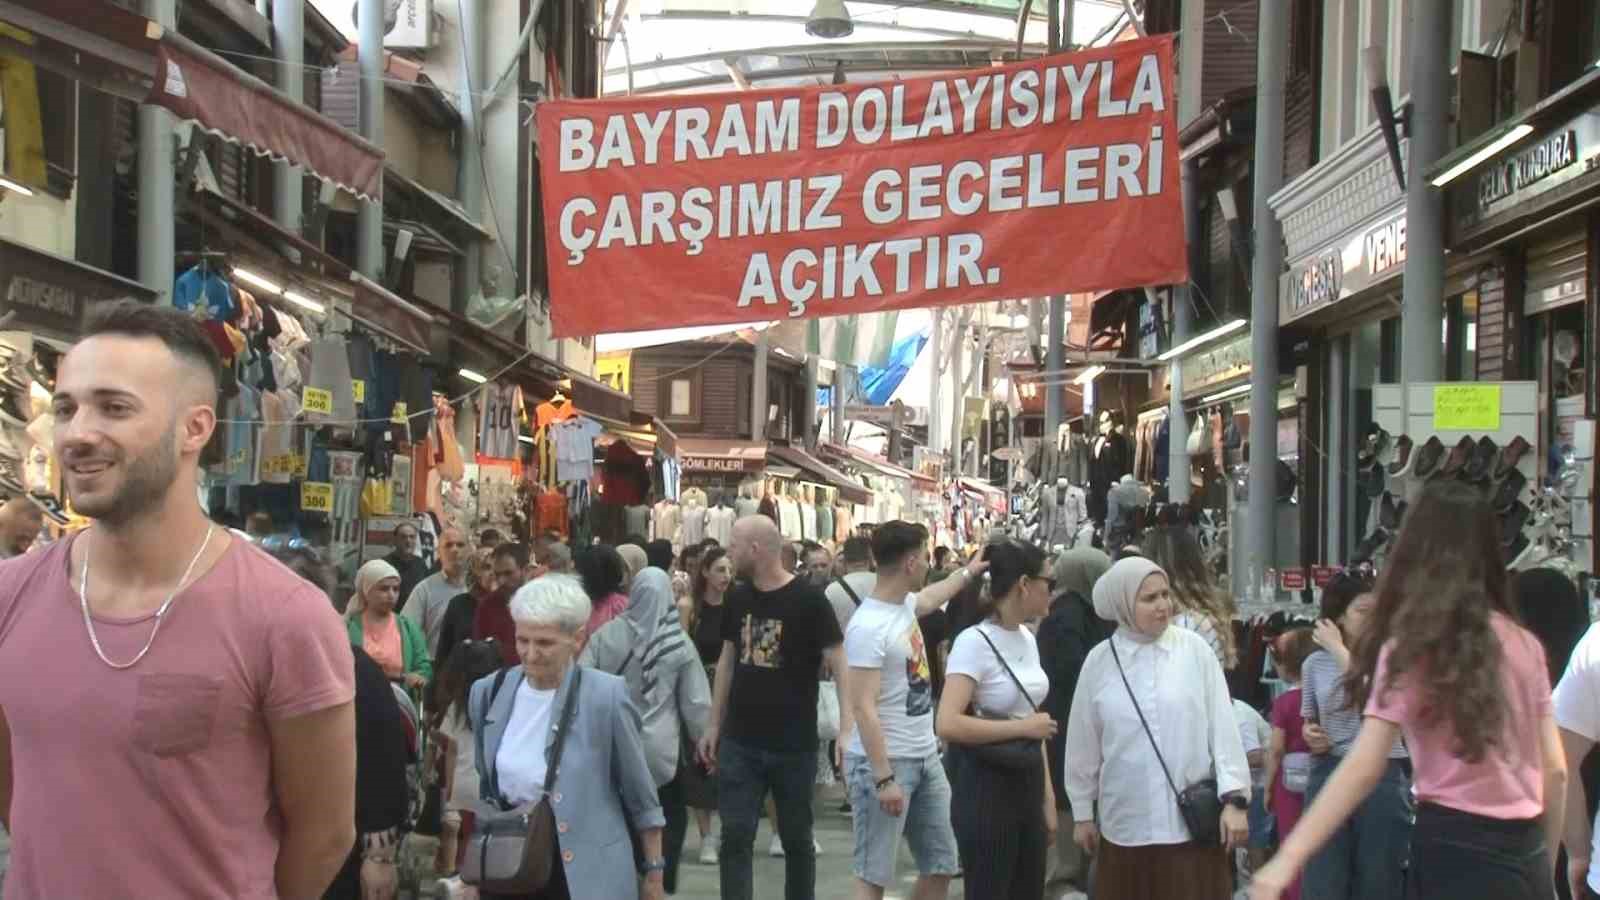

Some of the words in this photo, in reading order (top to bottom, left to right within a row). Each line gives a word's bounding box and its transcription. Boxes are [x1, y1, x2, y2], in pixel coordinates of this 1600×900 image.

[559, 97, 801, 172] BAYRAM
[815, 53, 1166, 149] DOLAYISIYLA
[558, 173, 844, 266] ÇARŞIMIZ
[862, 125, 1165, 225] GECELERİ
[1514, 128, 1577, 191] KUNDURA
[736, 232, 1001, 317] AÇIKTIR.
[489, 402, 511, 430] 10
[680, 455, 744, 472] GÖMLEKLERİ
